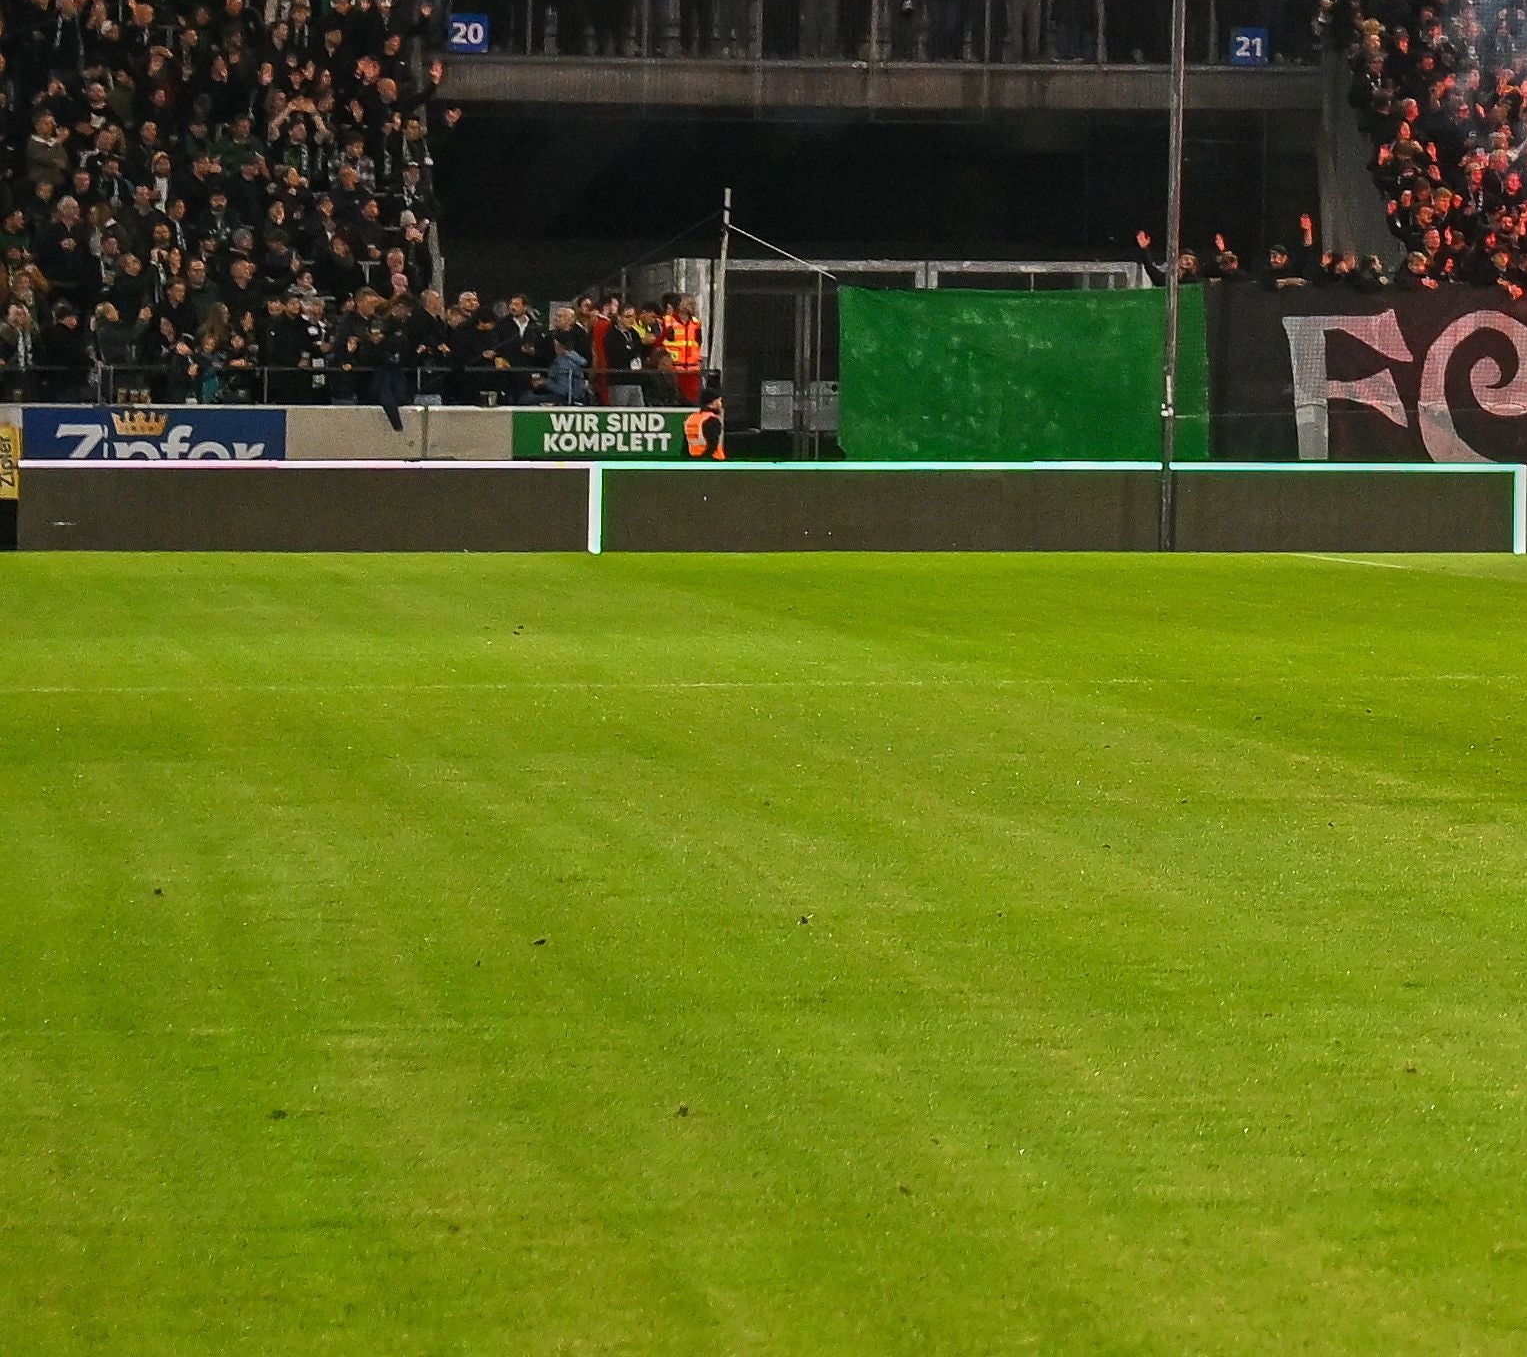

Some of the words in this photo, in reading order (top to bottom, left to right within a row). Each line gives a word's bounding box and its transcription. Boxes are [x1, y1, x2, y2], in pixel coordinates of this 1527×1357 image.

[451, 21, 484, 45] 20
[1235, 35, 1262, 57] 21
[550, 413, 599, 432] WIR
[606, 413, 666, 432] SIND
[543, 433, 672, 453] KOMPLETT
